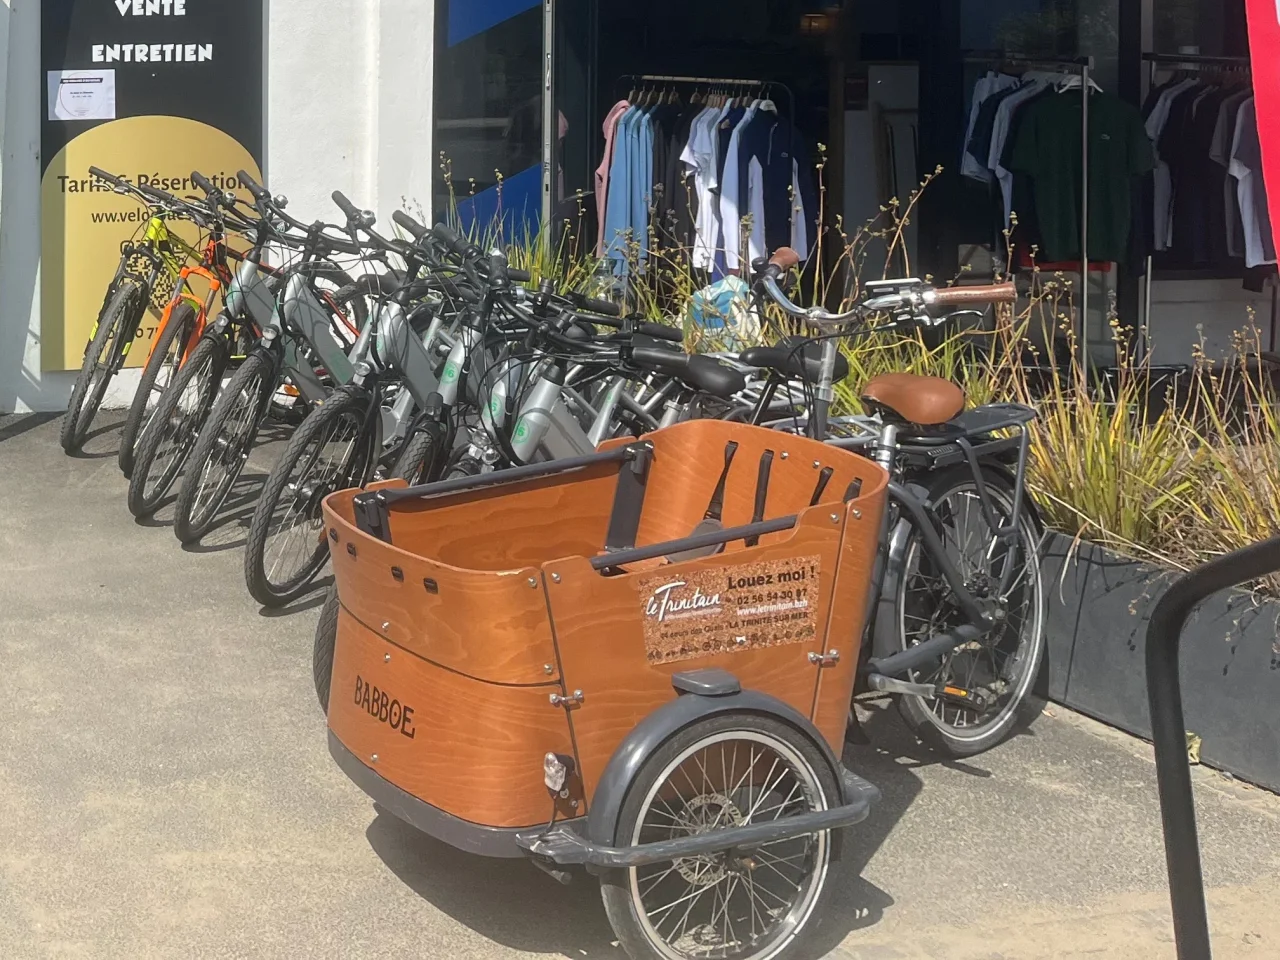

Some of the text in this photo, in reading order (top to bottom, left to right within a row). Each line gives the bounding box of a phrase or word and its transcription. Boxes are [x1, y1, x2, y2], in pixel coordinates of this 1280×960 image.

[92, 43, 213, 62] ENTRETIEN
[727, 566, 815, 590] Louez moi !
[737, 596, 749, 605] 02
[751, 594, 764, 604] 56
[354, 674, 416, 740] BABBOE
